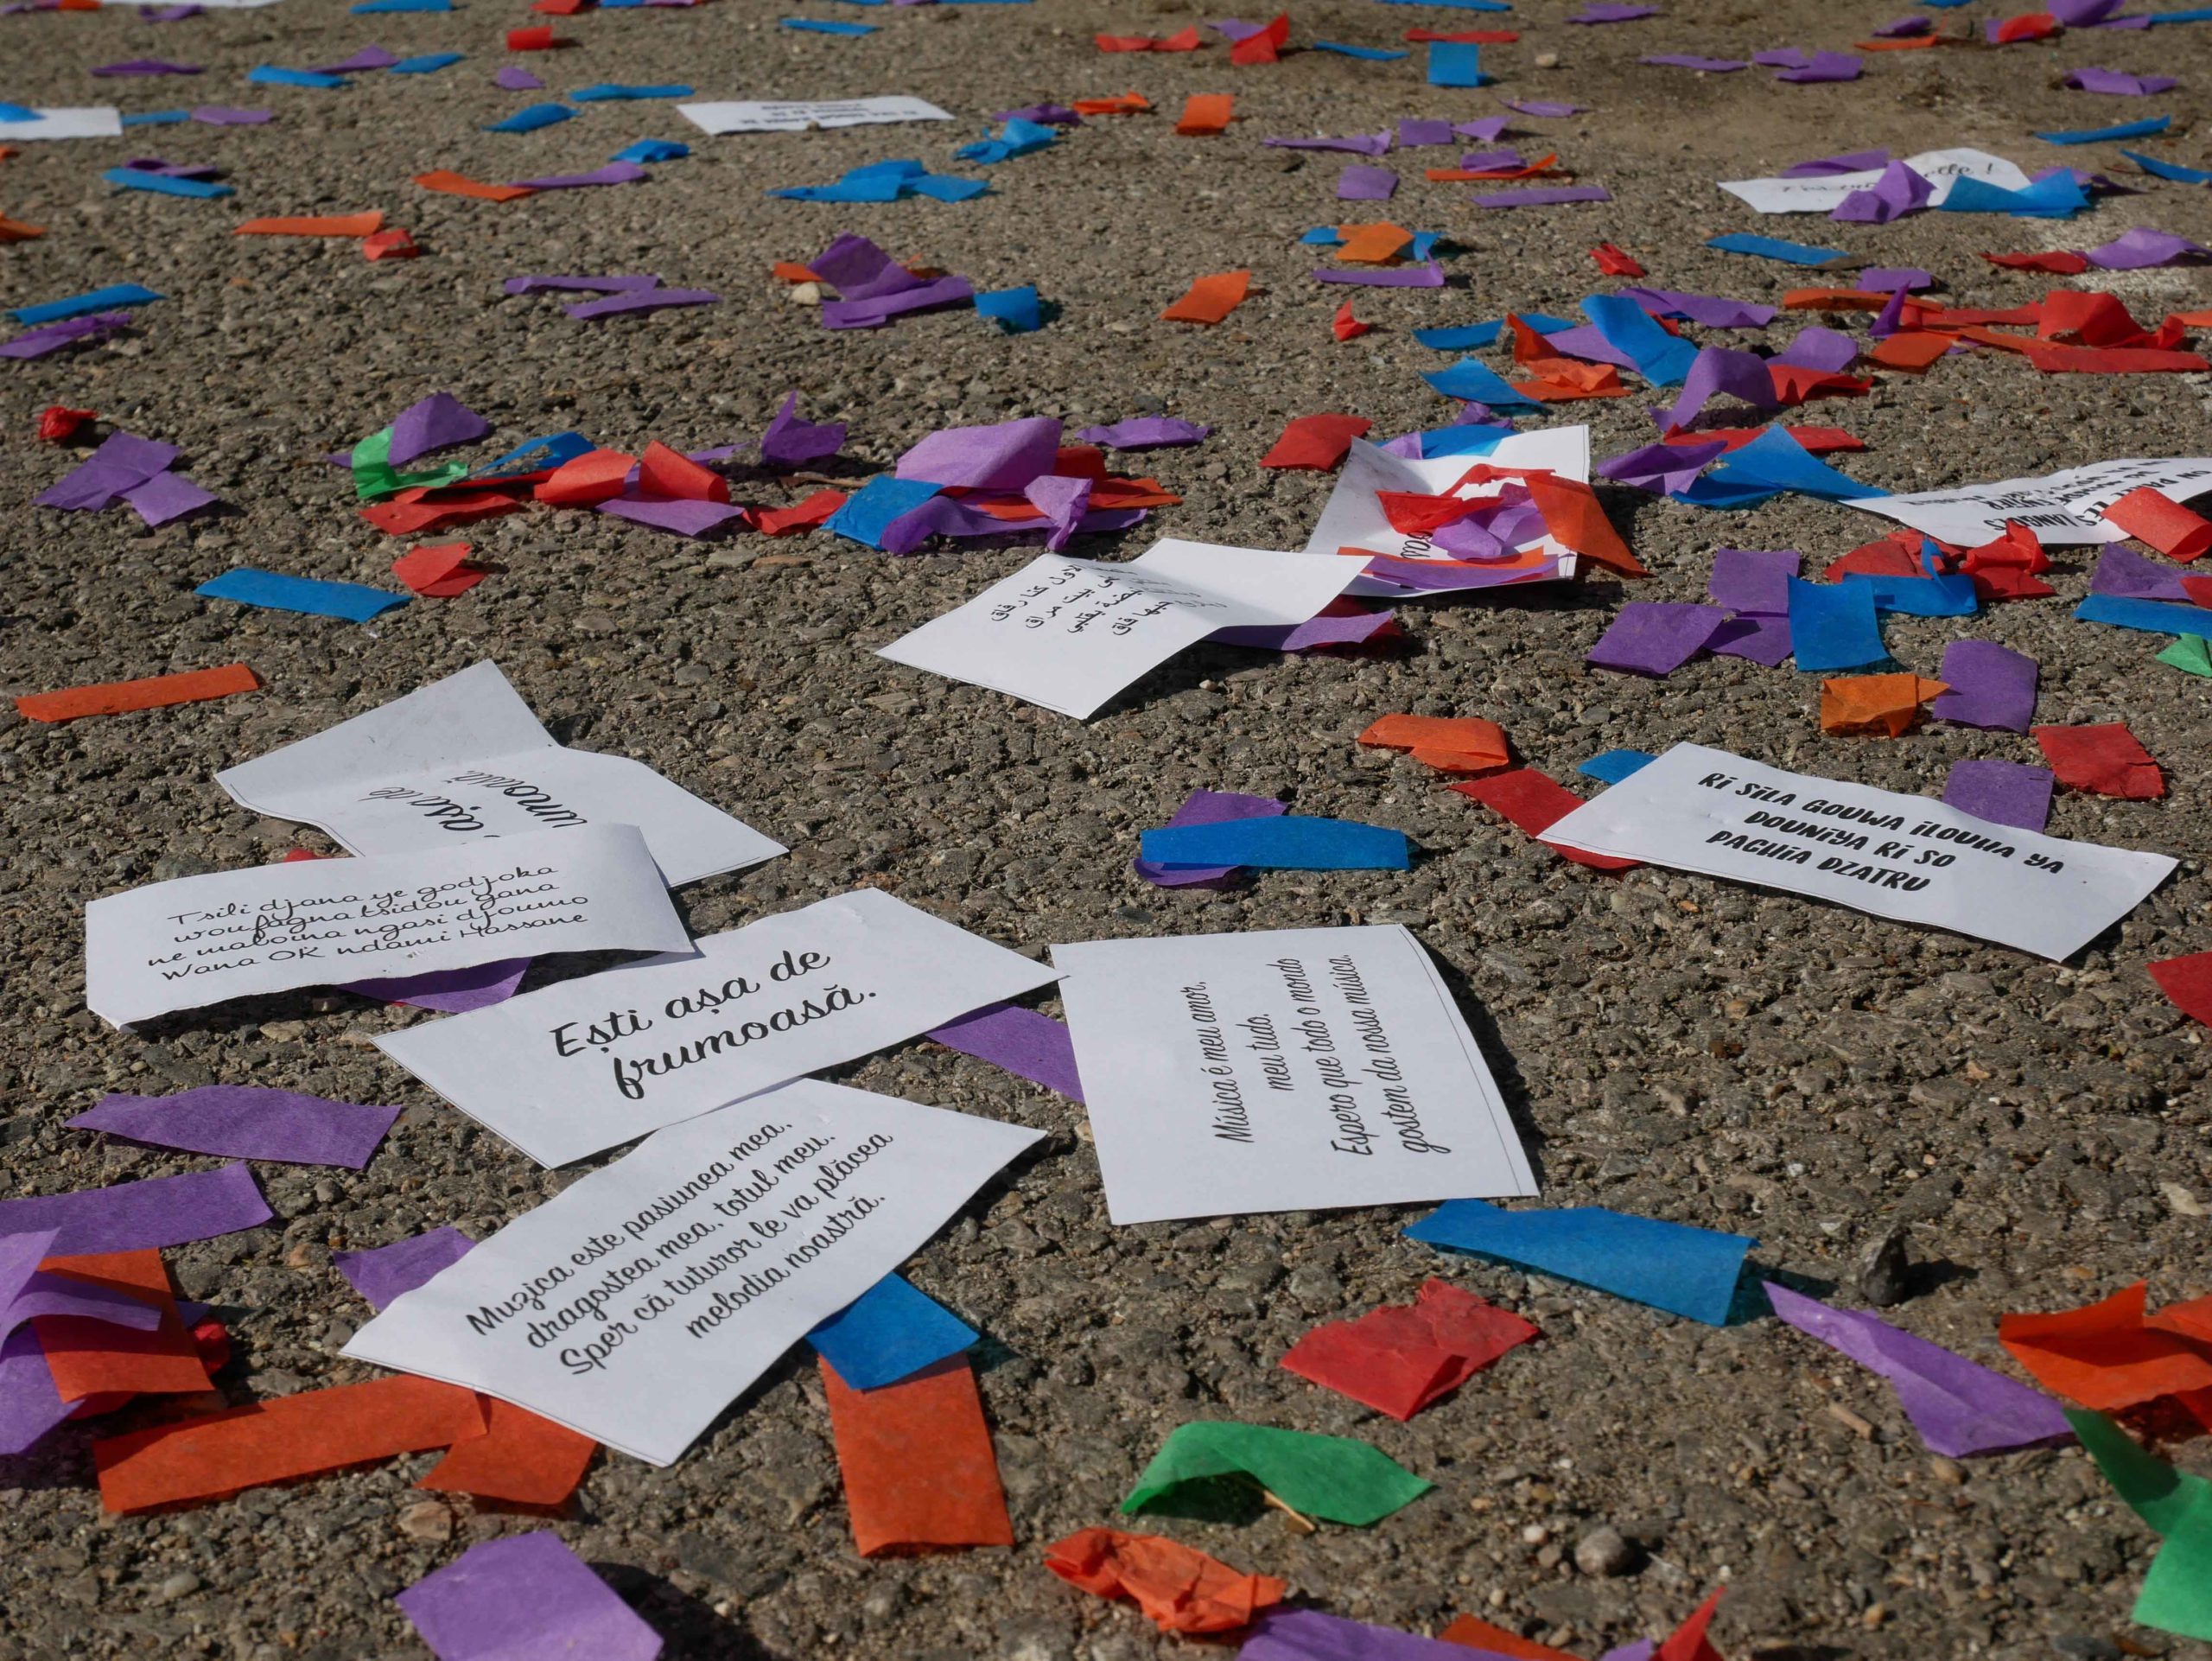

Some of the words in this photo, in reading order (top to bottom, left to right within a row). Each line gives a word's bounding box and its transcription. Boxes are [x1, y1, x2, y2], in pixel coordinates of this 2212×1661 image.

[1802, 799, 1905, 831] GOUWA
[2024, 853, 2064, 874] YA
[1913, 850, 1956, 868] SO
[168, 903, 251, 925] Tsili
[259, 899, 363, 920] djana
[370, 890, 408, 908] ye
[417, 867, 558, 902] godjoka
[1816, 857, 1930, 891] DZATRU
[149, 952, 187, 966] ne
[354, 913, 448, 941] ngasi
[456, 896, 588, 931] djoumo
[175, 913, 355, 942] woufagna
[361, 897, 467, 918] tsidou
[475, 883, 560, 911] gana
[161, 958, 260, 980] Wana
[269, 946, 326, 961] OK
[338, 931, 451, 954] ndami
[460, 913, 588, 938] Hassane
[665, 977, 760, 1015] așa
[770, 951, 830, 982] de
[1265, 958, 1317, 1002] mondo
[1328, 955, 1370, 1005] música.
[1236, 1014, 1280, 1051] tudo.
[1290, 1020, 1336, 1052] todo
[1297, 1007, 1320, 1015] o
[1351, 1008, 1391, 1053] nossa
[613, 984, 877, 1099] frumoasă.
[1196, 1026, 1230, 1061] meu
[1200, 1065, 1233, 1075] é
[1361, 1057, 1402, 1081] da
[1259, 1054, 1294, 1091] meu
[1315, 1056, 1363, 1088] que
[1211, 1079, 1255, 1142] Música
[1330, 1094, 1380, 1155] Espero
[1380, 1085, 1452, 1154] gostem
[465, 1266, 575, 1336] Muzica
[571, 1234, 626, 1265] este
[622, 1161, 734, 1241] pasiunea
[527, 1257, 660, 1348] dragostea
[713, 1169, 779, 1217] totul
[560, 1321, 639, 1375] Sper
[633, 1294, 675, 1321] că
[663, 1238, 762, 1295] tuturor
[748, 1219, 787, 1238] le
[780, 1193, 819, 1219] va
[813, 1133, 893, 1200] plăcea
[686, 1267, 791, 1339] melodia
[785, 1195, 886, 1269] noastră.
